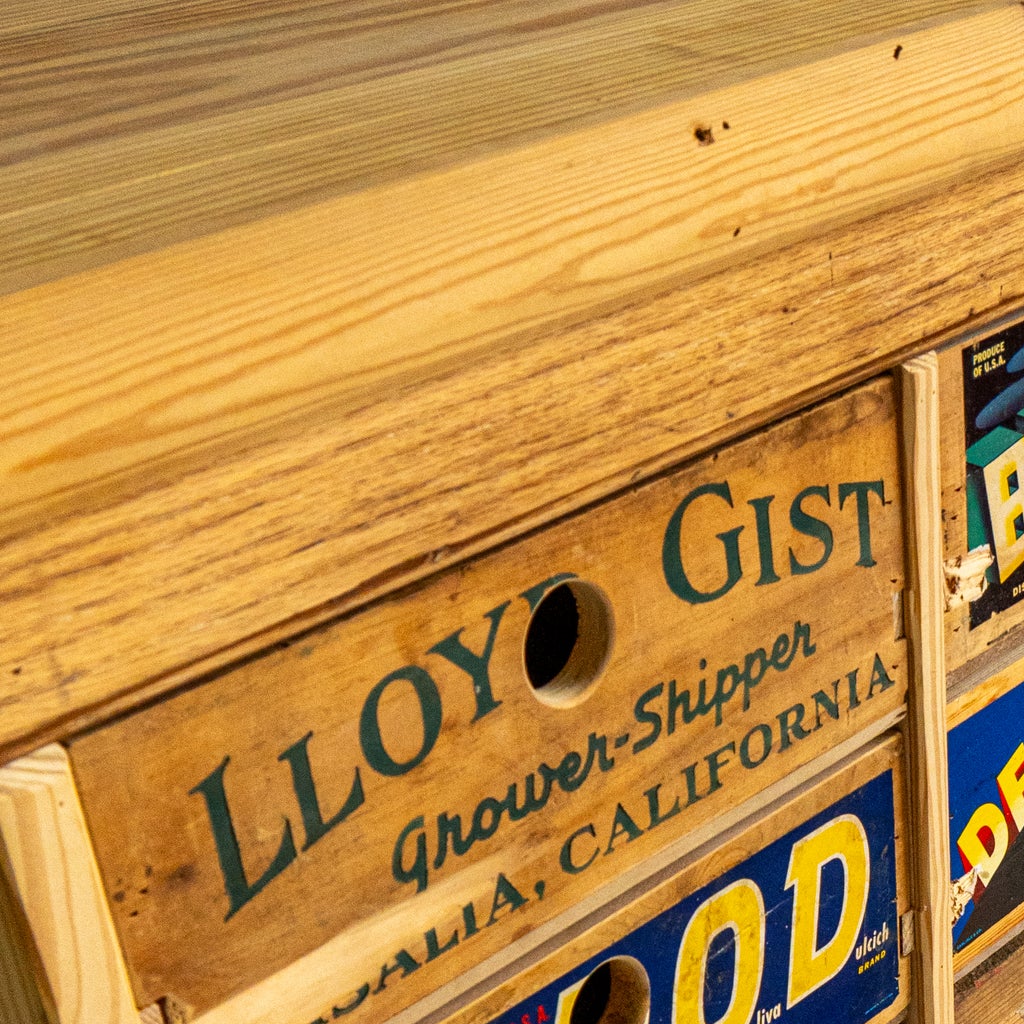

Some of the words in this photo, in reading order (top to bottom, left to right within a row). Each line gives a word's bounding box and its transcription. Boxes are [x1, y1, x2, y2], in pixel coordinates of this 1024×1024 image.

[973, 341, 1006, 366] PRODUCE
[973, 366, 982, 378] OF
[984, 356, 1007, 374] U.S.A.
[189, 572, 579, 924] LLOY
[661, 480, 887, 606] GIST
[393, 620, 817, 895] Grower-Shipper
[559, 651, 896, 876] CALIFORNIA
[855, 921, 889, 960] ulcich
[857, 949, 887, 975] BRAND
